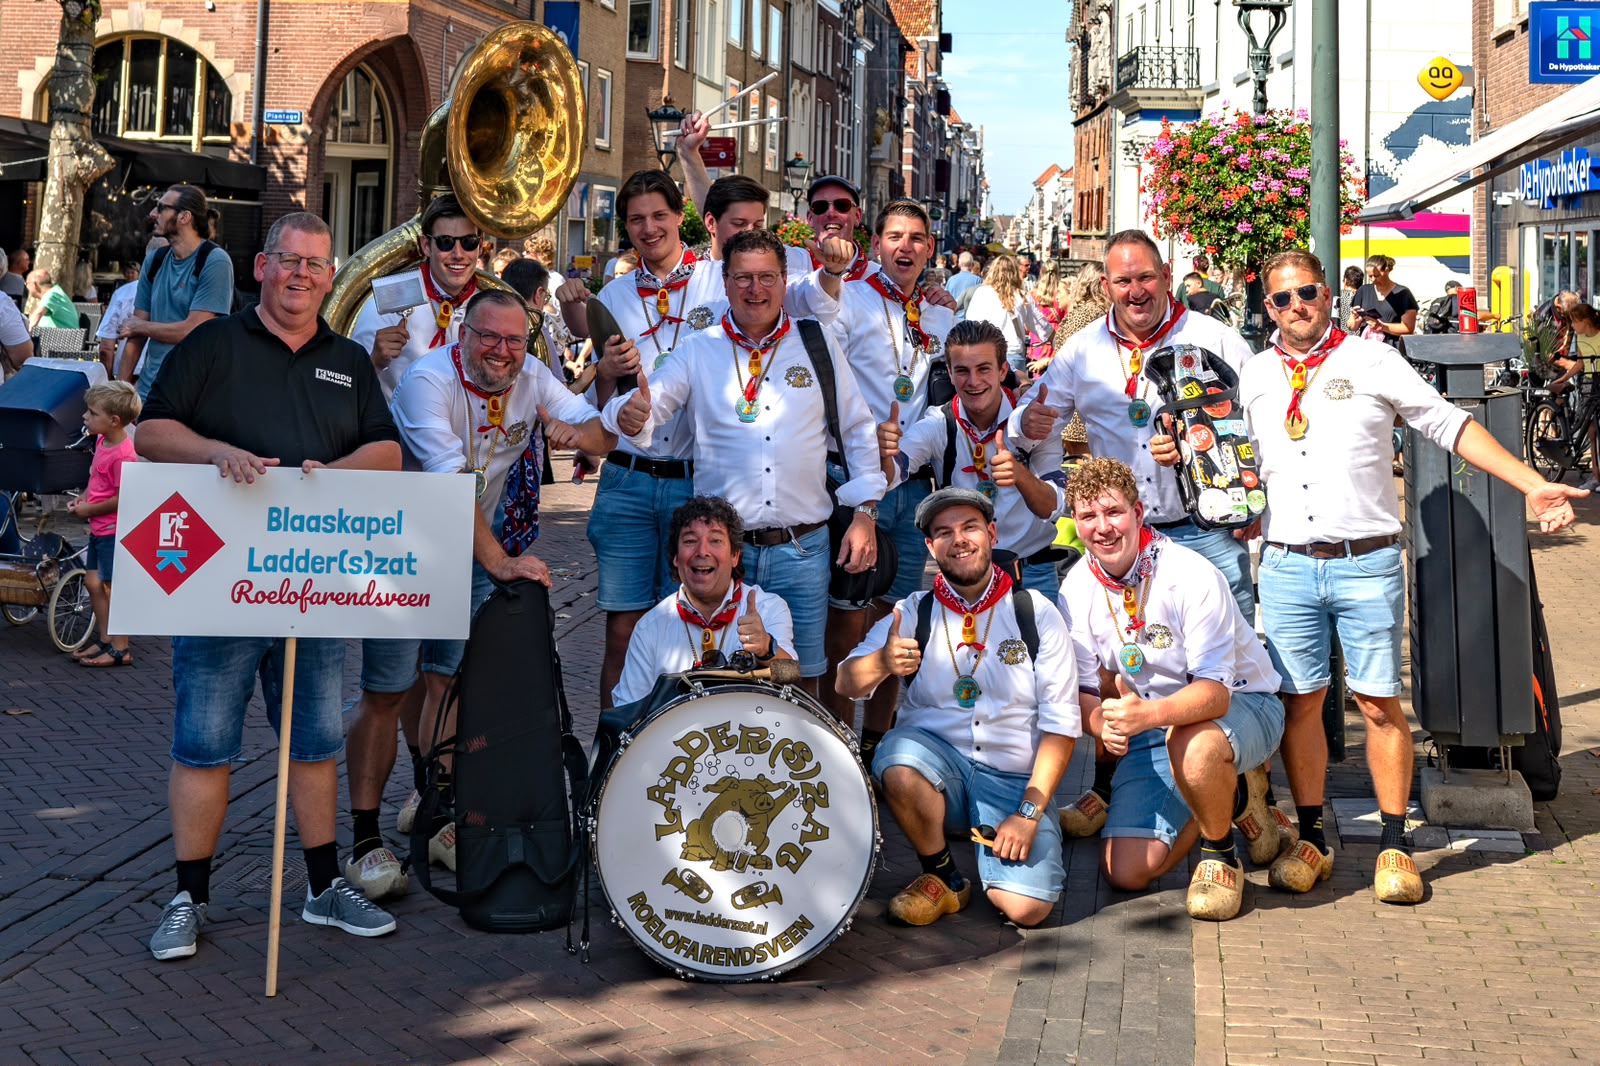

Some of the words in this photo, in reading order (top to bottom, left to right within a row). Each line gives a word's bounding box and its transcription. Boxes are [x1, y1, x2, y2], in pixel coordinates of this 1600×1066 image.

[1548, 62, 1559, 70] De
[1559, 62, 1600, 72] Hypotheker
[266, 506, 404, 541] Blaaskapel
[247, 547, 418, 576] Ladder(s)zat
[230, 578, 431, 613] Roelofarendsveen
[626, 890, 815, 968] ROELOFARENDSVEEN
[664, 907, 769, 936] www.ladderszat.nl
